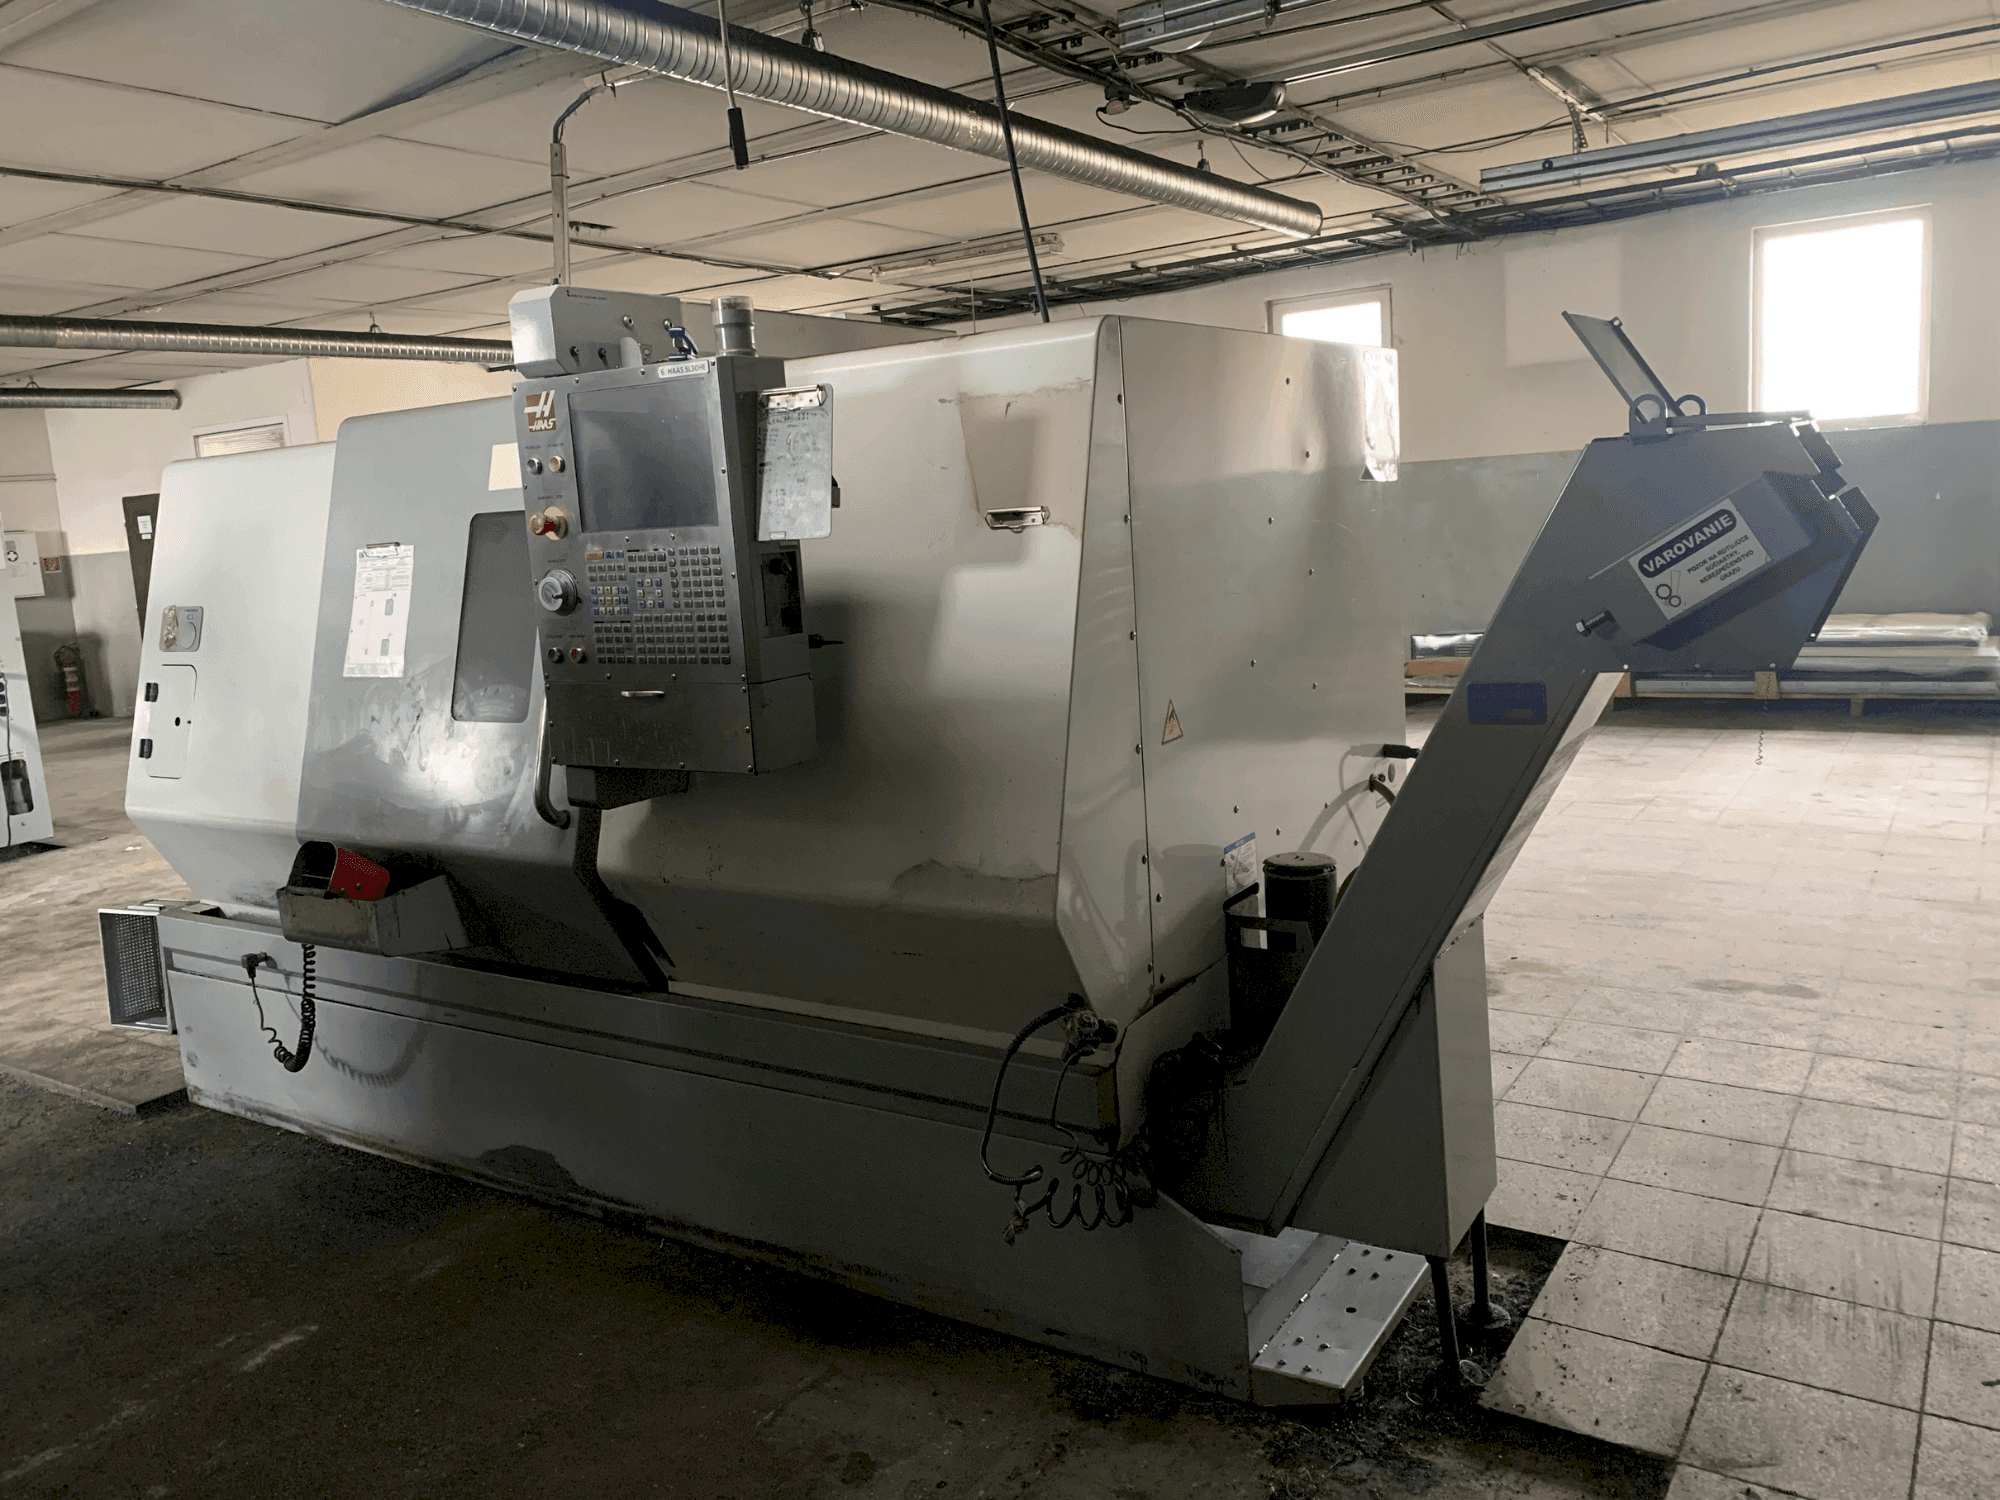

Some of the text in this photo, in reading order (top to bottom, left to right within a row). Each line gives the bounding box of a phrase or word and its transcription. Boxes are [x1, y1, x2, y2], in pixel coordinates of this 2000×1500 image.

[667, 365, 685, 375] HAAS
[528, 418, 556, 431] HAAS
[1642, 514, 1734, 573] VAROVANIE
[1687, 557, 1709, 574] POZOR
[1699, 549, 1755, 584] NEBEZPEČENSTVO
